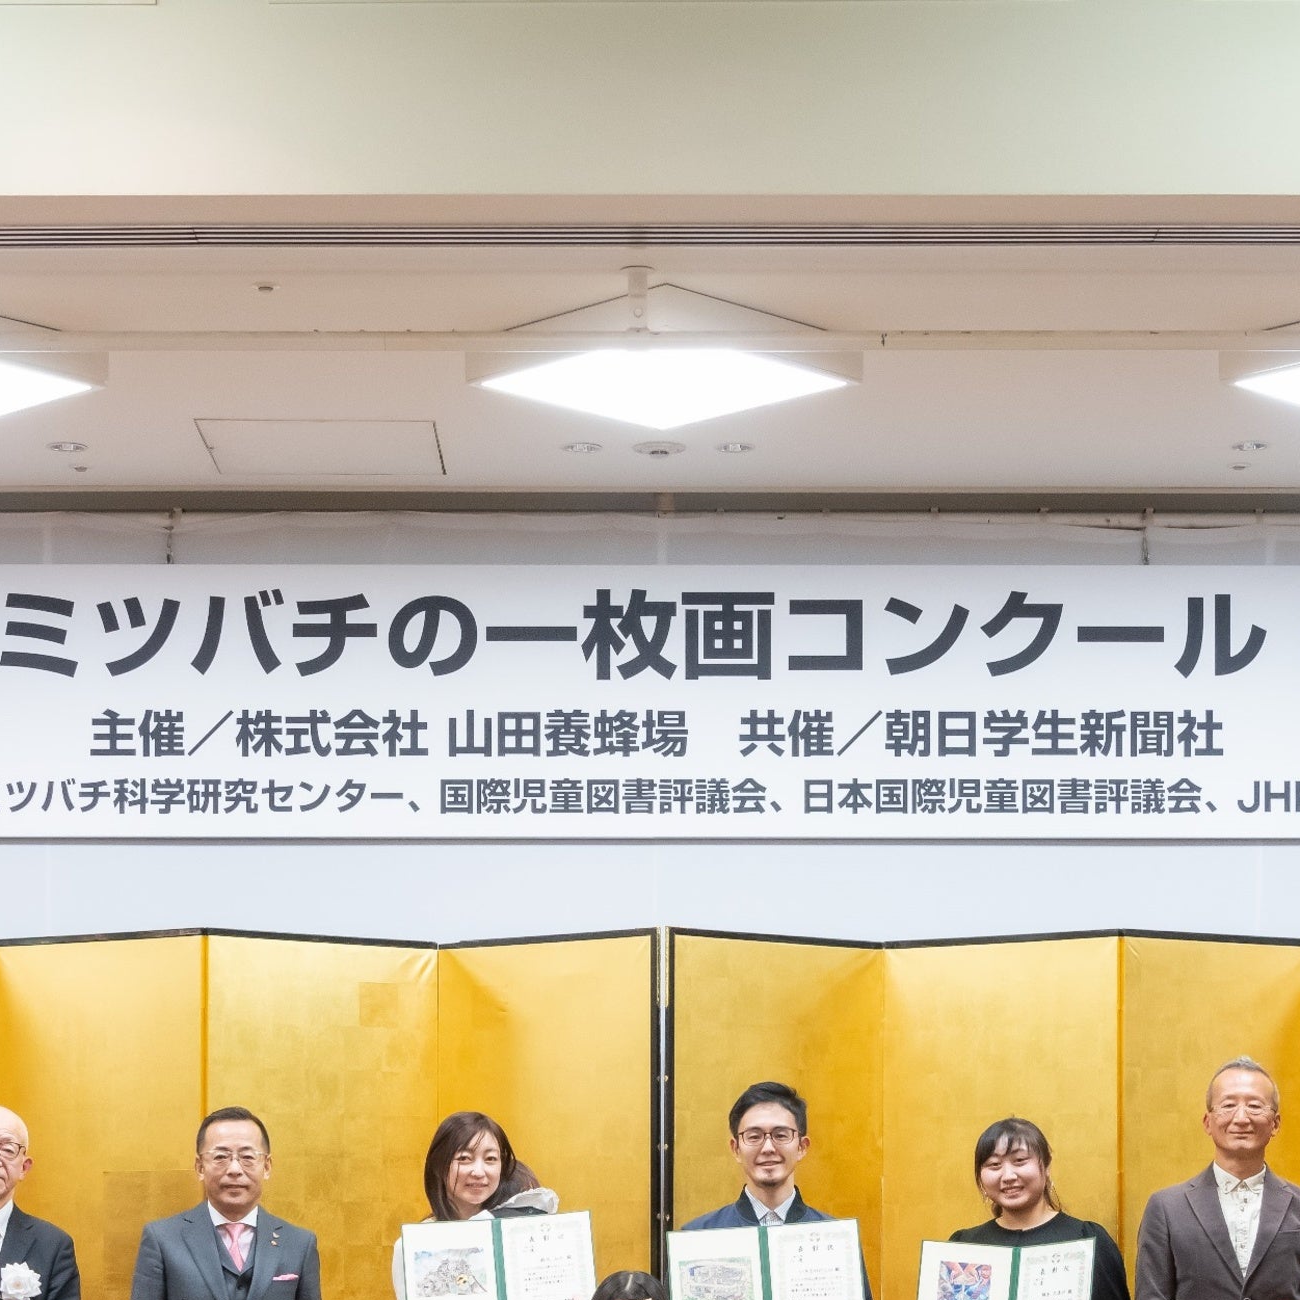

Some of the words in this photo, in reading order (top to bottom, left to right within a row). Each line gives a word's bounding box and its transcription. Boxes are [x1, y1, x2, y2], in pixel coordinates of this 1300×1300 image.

[90, 709, 429, 757] 主催／株式会社
[448, 709, 689, 757] 山田養蜂場
[739, 709, 1224, 757] 共催／朝日学生新聞社
